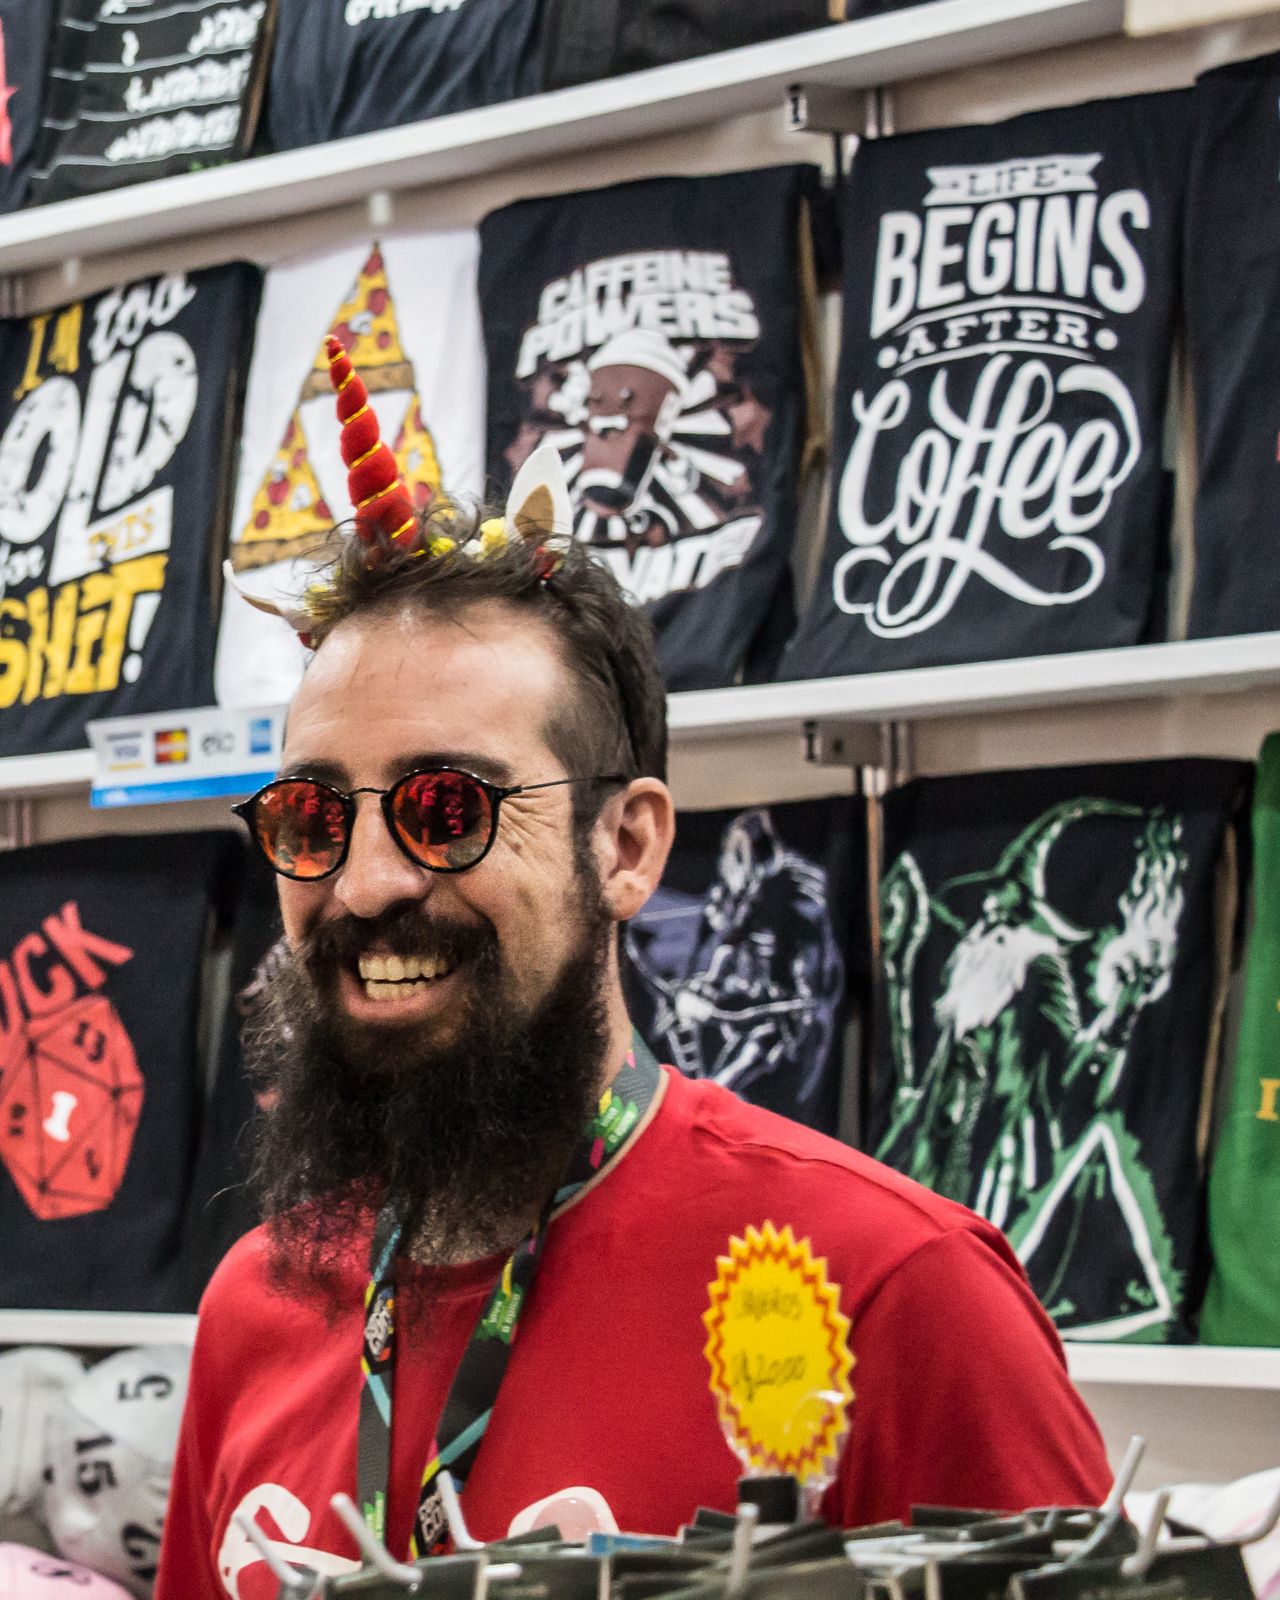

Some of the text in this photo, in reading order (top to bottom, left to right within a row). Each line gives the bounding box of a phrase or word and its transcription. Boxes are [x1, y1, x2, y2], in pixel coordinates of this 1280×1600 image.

[966, 163, 1060, 197] LIFE
[538, 250, 733, 326] CAFFEINE
[871, 189, 1151, 338] BEGINS
[516, 287, 761, 379] POWERS
[900, 310, 1090, 362] AFTER
[833, 353, 1141, 639] Coffee
[42, 1090, 78, 1142] 1
